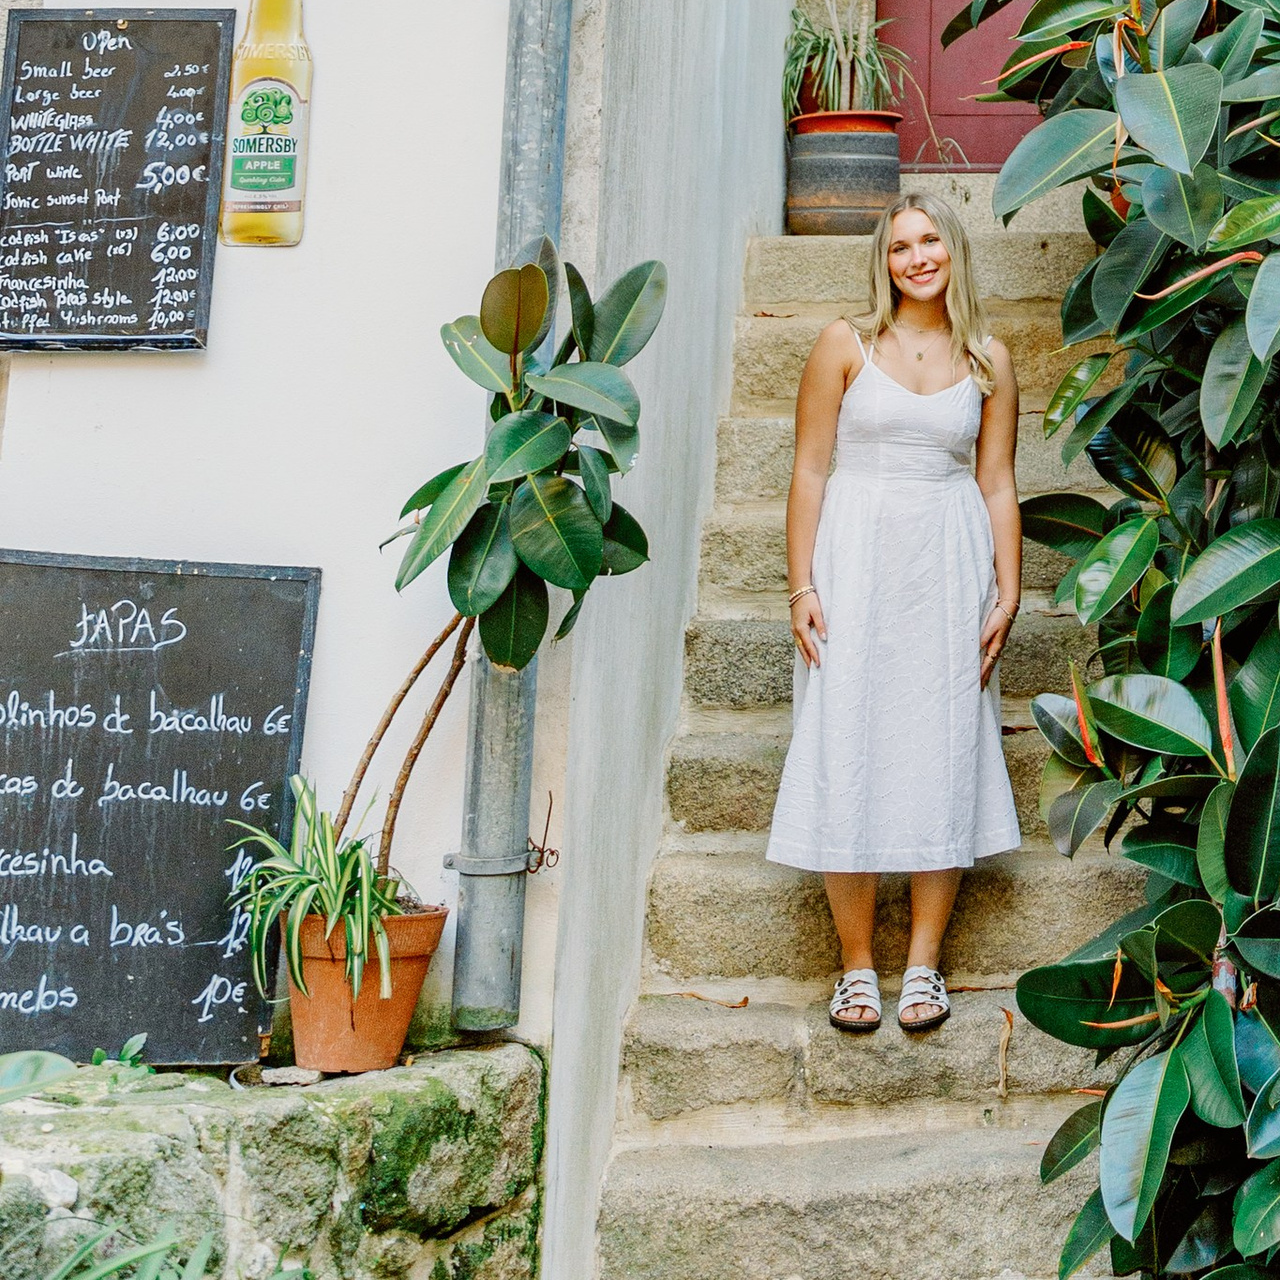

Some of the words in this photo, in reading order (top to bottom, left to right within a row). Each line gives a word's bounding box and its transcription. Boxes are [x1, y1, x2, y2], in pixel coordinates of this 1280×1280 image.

[20, 60, 73, 80] Small
[82, 57, 116, 80] beer
[15, 85, 60, 107] Large
[70, 83, 102, 100] beer
[232, 137, 298, 154] SOMERSBY
[245, 160, 281, 170] APPLE
[91, 287, 133, 309] style
[0, 311, 51, 334] tuffed
[150, 690, 251, 735] bacalhau
[263, 704, 292, 735] 6€
[98, 763, 228, 807] bacalhau
[239, 781, 272, 810] 6€
[0, 832, 114, 877] cesinha
[0, 903, 62, 945] lhau
[70, 924, 90, 946] a
[191, 974, 248, 1022] 10€
